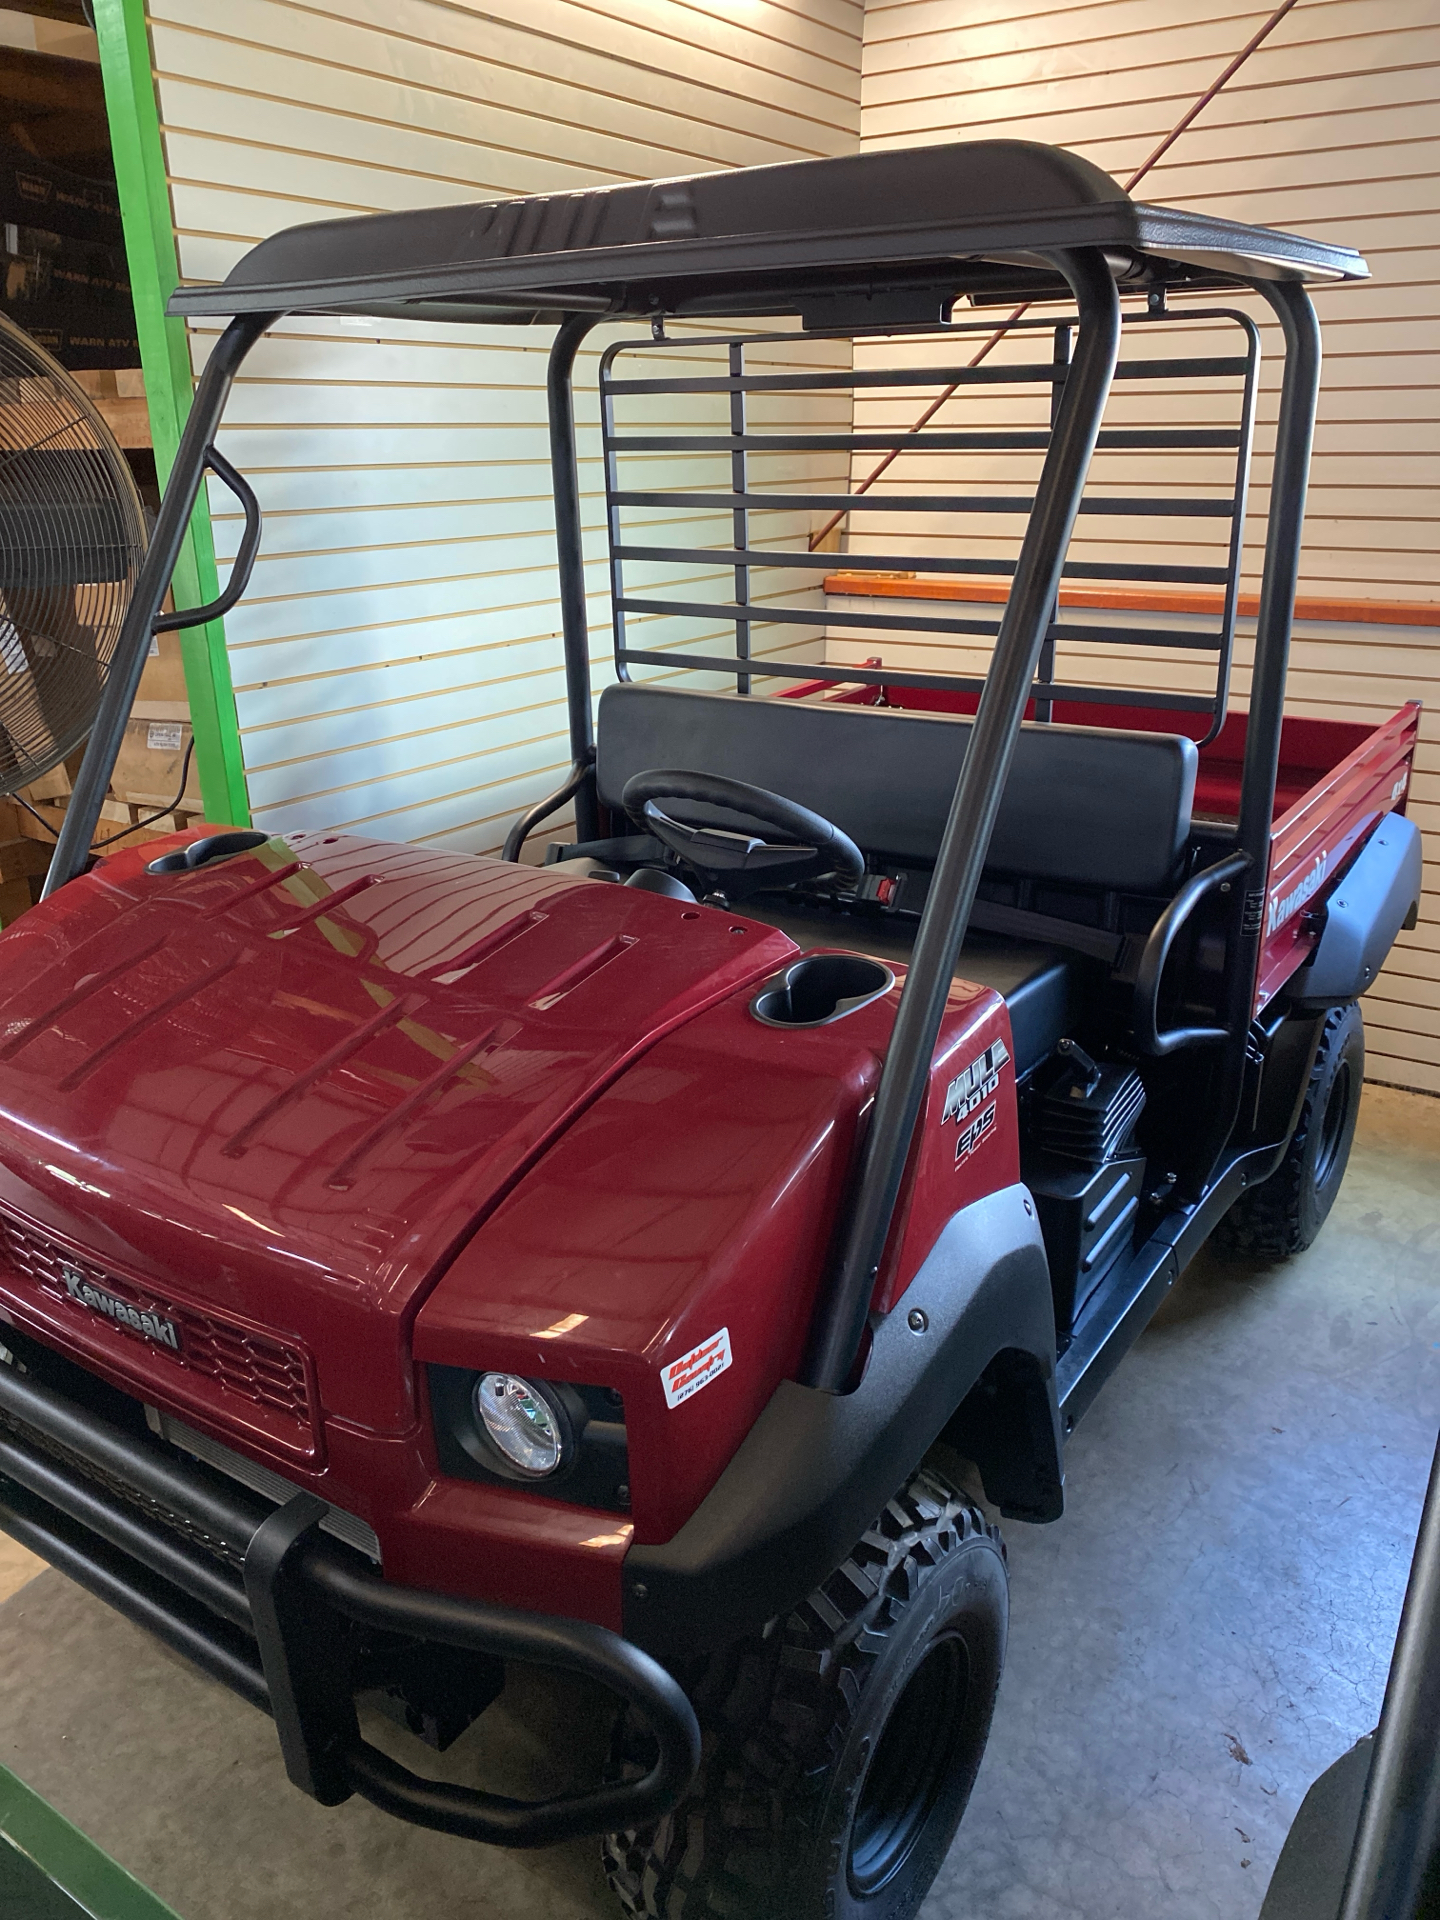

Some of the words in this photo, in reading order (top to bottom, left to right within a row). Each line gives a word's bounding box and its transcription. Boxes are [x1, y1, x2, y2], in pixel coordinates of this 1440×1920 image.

[69, 336, 105, 347] WARN
[108, 338, 130, 348] ATV
[1266, 850, 1327, 937] Kawasaki
[941, 1037, 1010, 1125] MULE
[956, 1073, 999, 1123] 4010
[955, 1100, 997, 1161] EPS
[63, 1268, 178, 1349] Kawasaki
